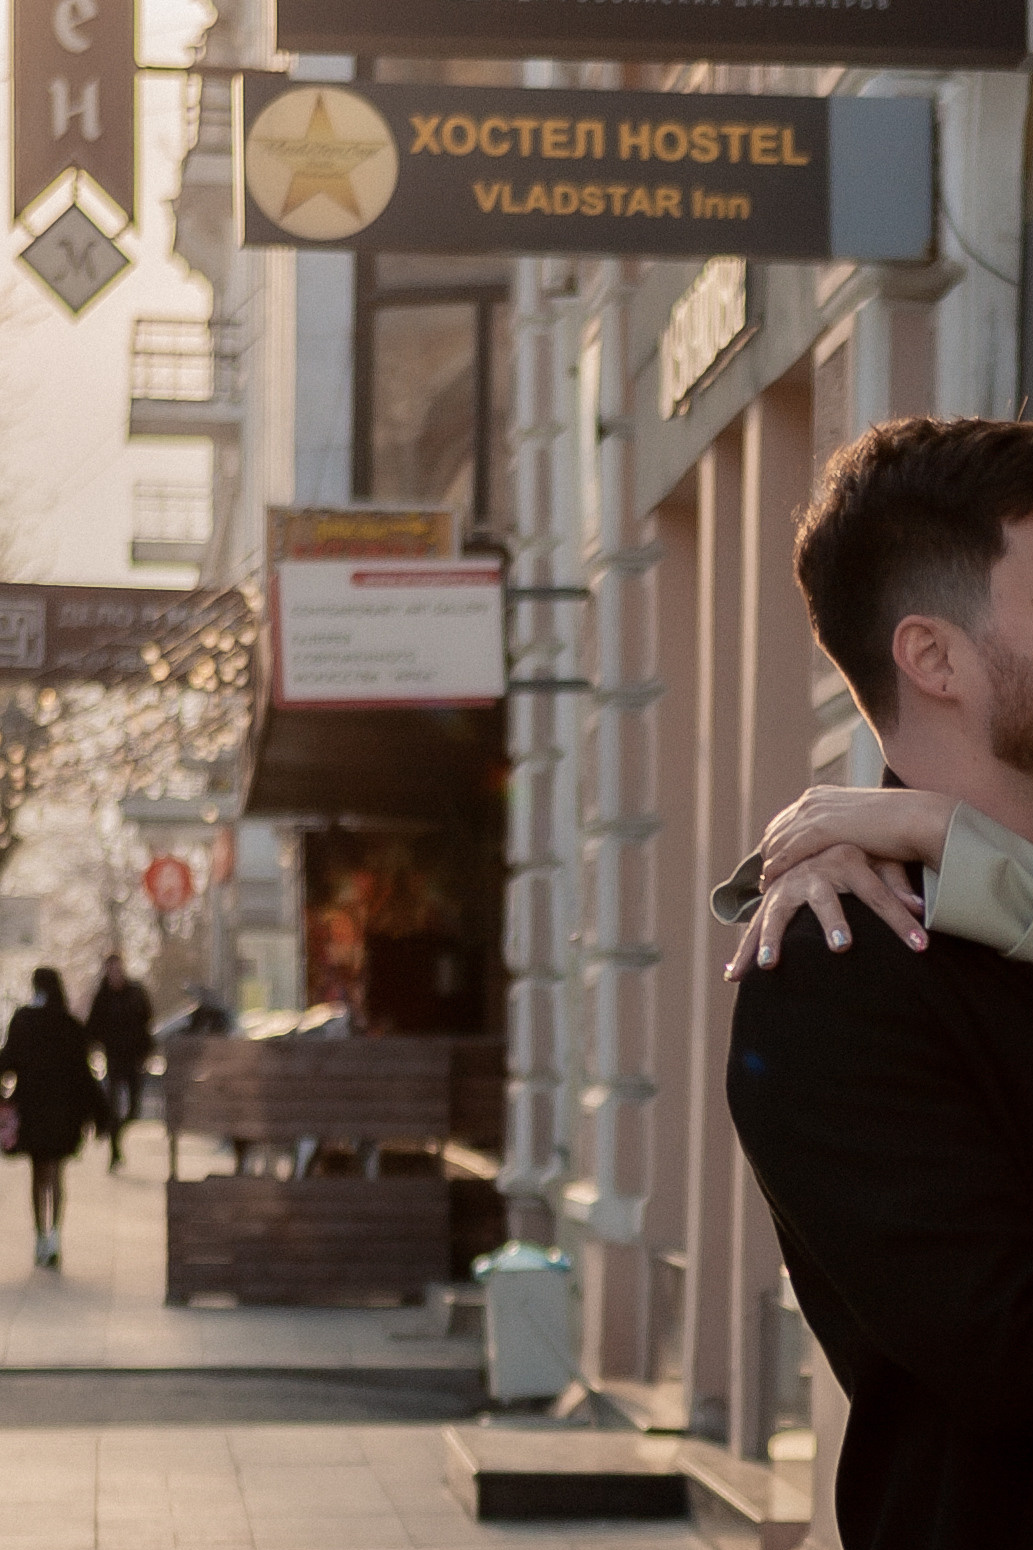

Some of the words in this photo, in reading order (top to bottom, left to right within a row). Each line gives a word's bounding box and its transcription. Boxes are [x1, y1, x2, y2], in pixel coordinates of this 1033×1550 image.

[410, 115, 605, 159] ХОСТЕЛ
[618, 121, 811, 167] HOSTEL
[473, 180, 683, 219] VLADSTAR
[692, 187, 752, 220] Inn
